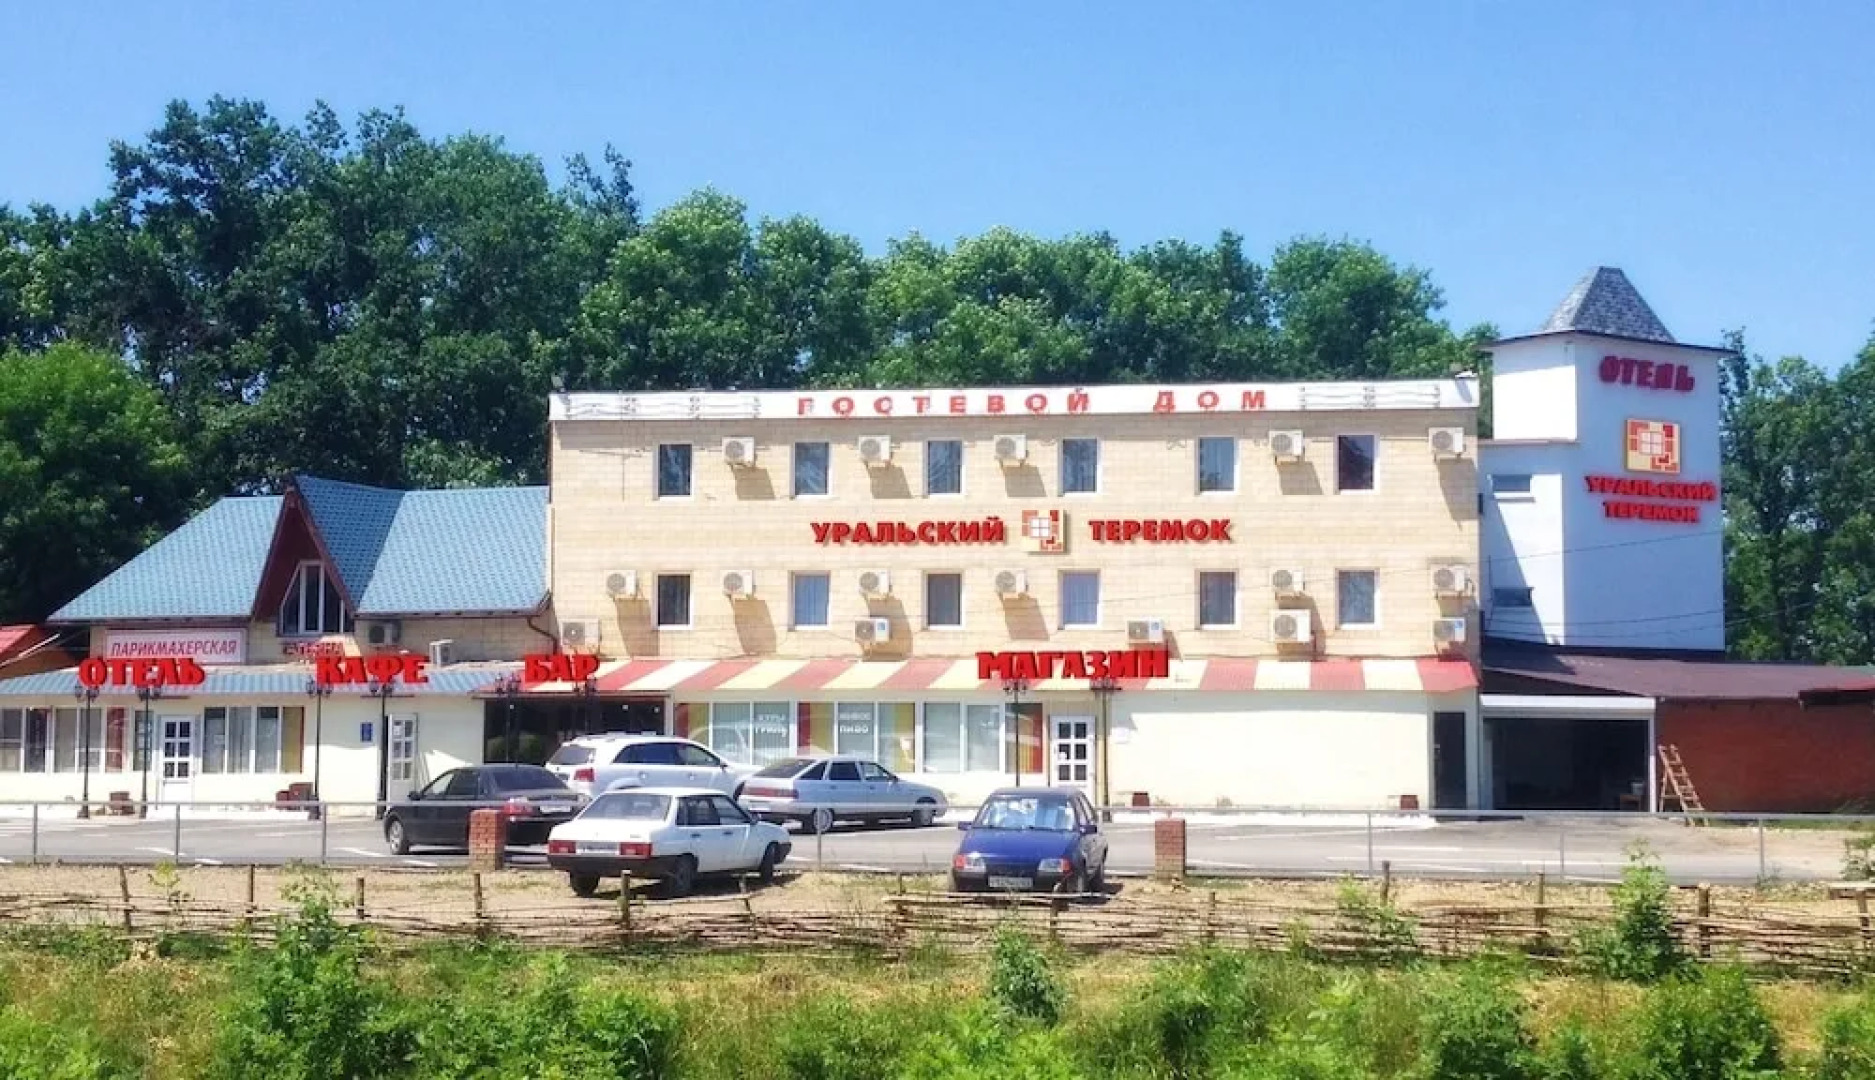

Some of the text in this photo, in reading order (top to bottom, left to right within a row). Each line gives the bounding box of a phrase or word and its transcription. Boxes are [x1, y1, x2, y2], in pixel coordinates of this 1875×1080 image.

[1600, 355, 1696, 392] ОТЕЛЬ
[797, 387, 1267, 418] ГОСТЕВОЙ ДОМ
[1585, 475, 1717, 502] УРАЛЬСКИЙ
[1603, 500, 1699, 525] ТЕРЕМОК
[810, 516, 1231, 544] УРАЛЬСКИЙ ТЕРЕМОК
[111, 639, 238, 657] ПАРИКМАХЕРСКАЯ
[79, 656, 206, 688] ОТЕЛЬ
[315, 654, 430, 684] КАФЕ
[524, 653, 600, 683] БАР
[975, 649, 1169, 680] МАГАЗИН
